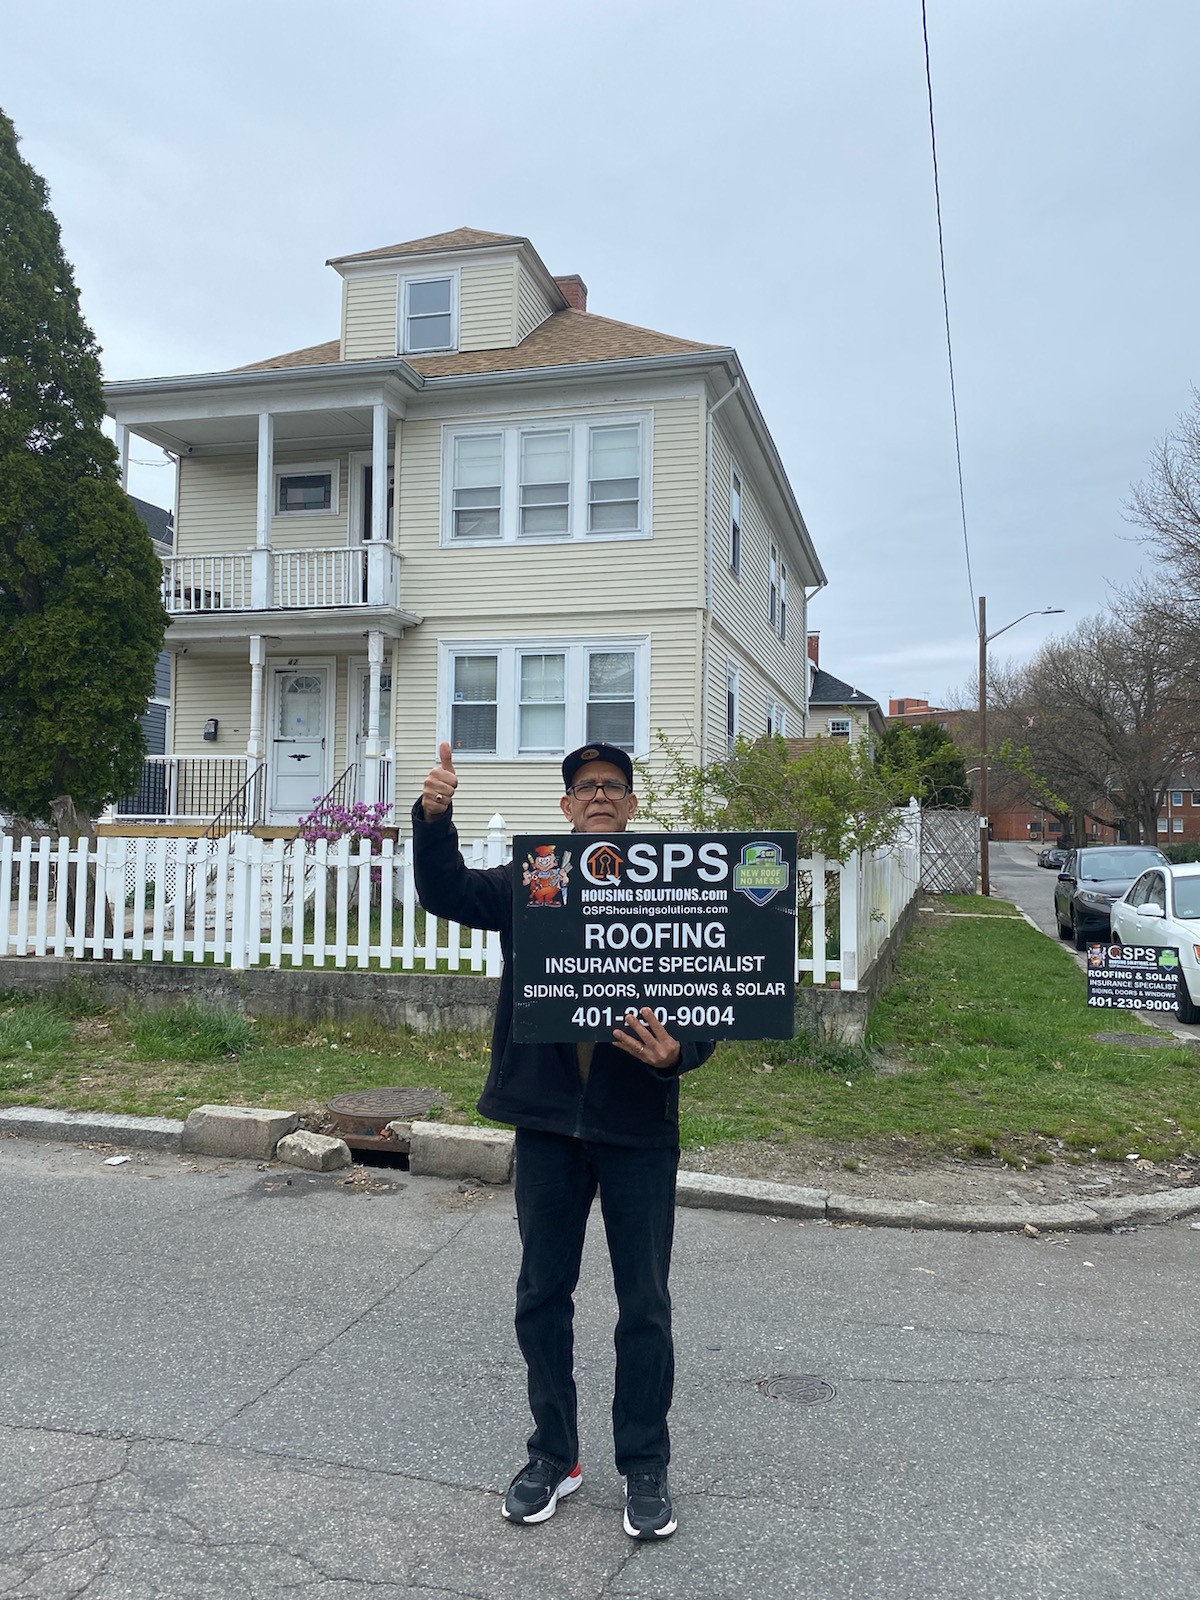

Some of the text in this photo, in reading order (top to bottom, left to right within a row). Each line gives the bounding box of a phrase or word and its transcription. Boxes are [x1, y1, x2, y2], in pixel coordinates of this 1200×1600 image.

[580, 841, 728, 887] QSPS
[740, 869, 781, 877] NEW ROOF
[740, 877, 781, 885] NO MESS
[581, 888, 728, 902] HOUSING SOLUTIONS.com
[582, 904, 729, 917] QSPShousingsolutions.com
[584, 922, 727, 950] ROOFING
[1107, 945, 1156, 961] QSPS
[545, 955, 765, 974] INSURANCE SPECIALIST
[1088, 970, 1179, 982] ROOFING & SOLAR
[523, 983, 786, 999] SIDING, DOORS, WINDOWS & SOLAR
[1089, 979, 1178, 990] INSURANCE SPECIALIST
[1088, 996, 1179, 1011] 401-230-9004
